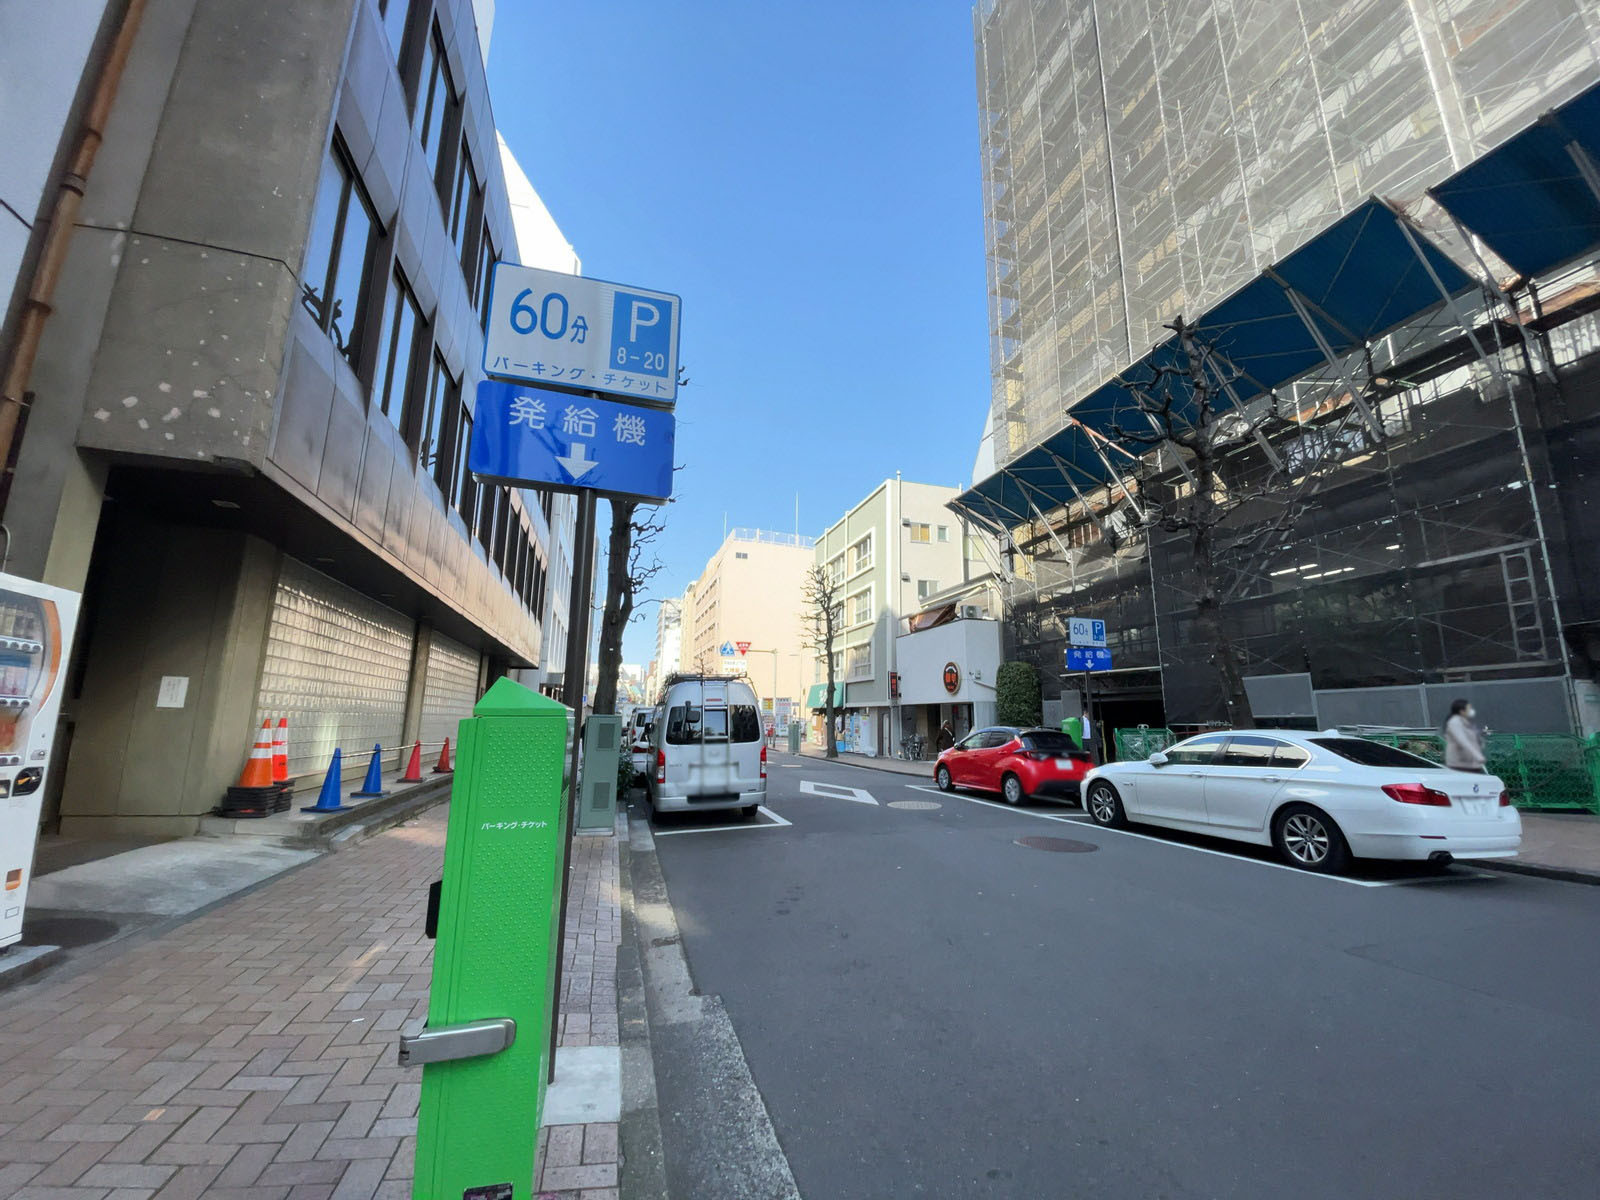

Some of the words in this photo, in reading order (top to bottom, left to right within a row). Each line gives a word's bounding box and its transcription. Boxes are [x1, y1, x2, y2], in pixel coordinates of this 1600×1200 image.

[510, 287, 589, 344] 60分
[629, 300, 660, 343] P
[493, 355, 667, 393] パーキング・チケット
[617, 347, 665, 371] 8-20
[509, 396, 646, 446] 発給機
[1095, 622, 1102, 634] P
[481, 821, 548, 830] パーキング・チケット
